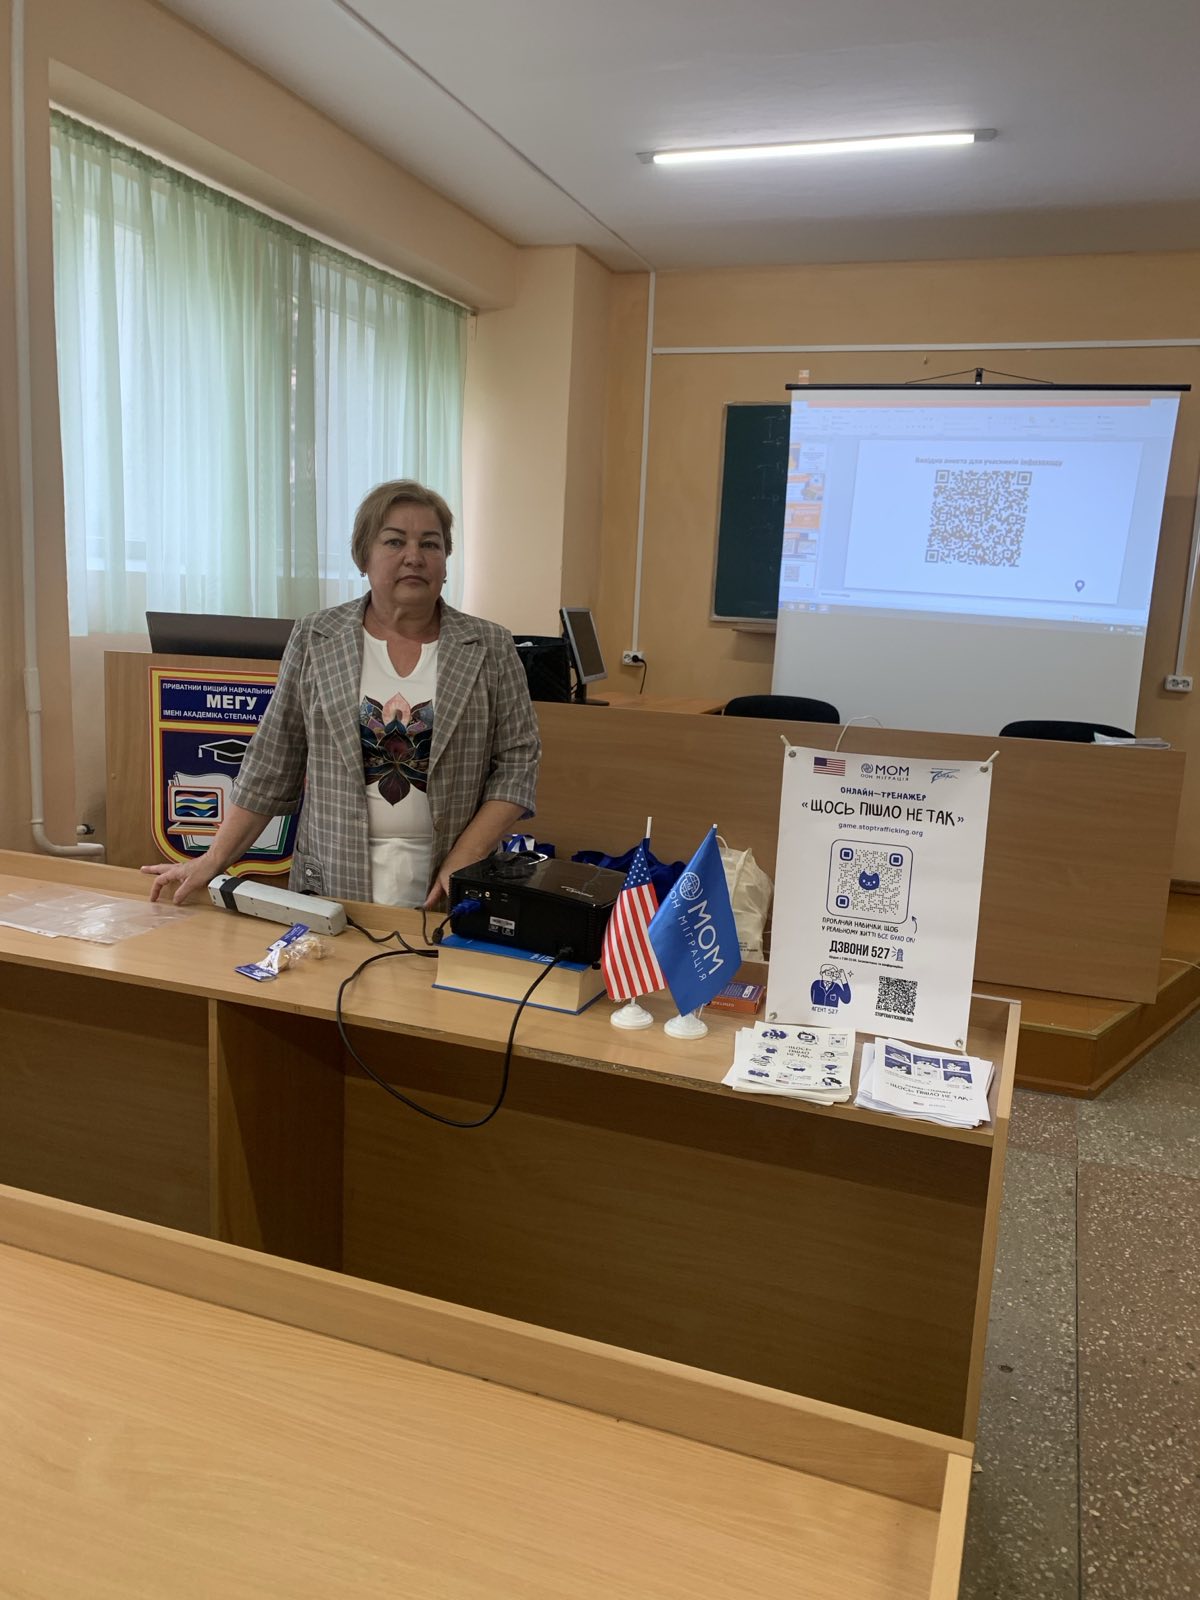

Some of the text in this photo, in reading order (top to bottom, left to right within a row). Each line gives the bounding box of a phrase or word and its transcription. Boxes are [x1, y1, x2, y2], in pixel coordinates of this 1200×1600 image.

[206, 694, 257, 710] МЕГУ
[163, 709, 182, 717] ІМЕНІ
[183, 711, 222, 719] АКАДЕМІКА
[224, 713, 257, 721] СТЕПАНА
[875, 764, 910, 776] МОМ
[859, 802, 902, 819] ПІШЛО
[906, 807, 923, 822] НЕ
[838, 821, 924, 837] game.stoptrafficking.org
[688, 899, 724, 976] МОМ
[829, 940, 890, 960] ДЗВОНИ 527
